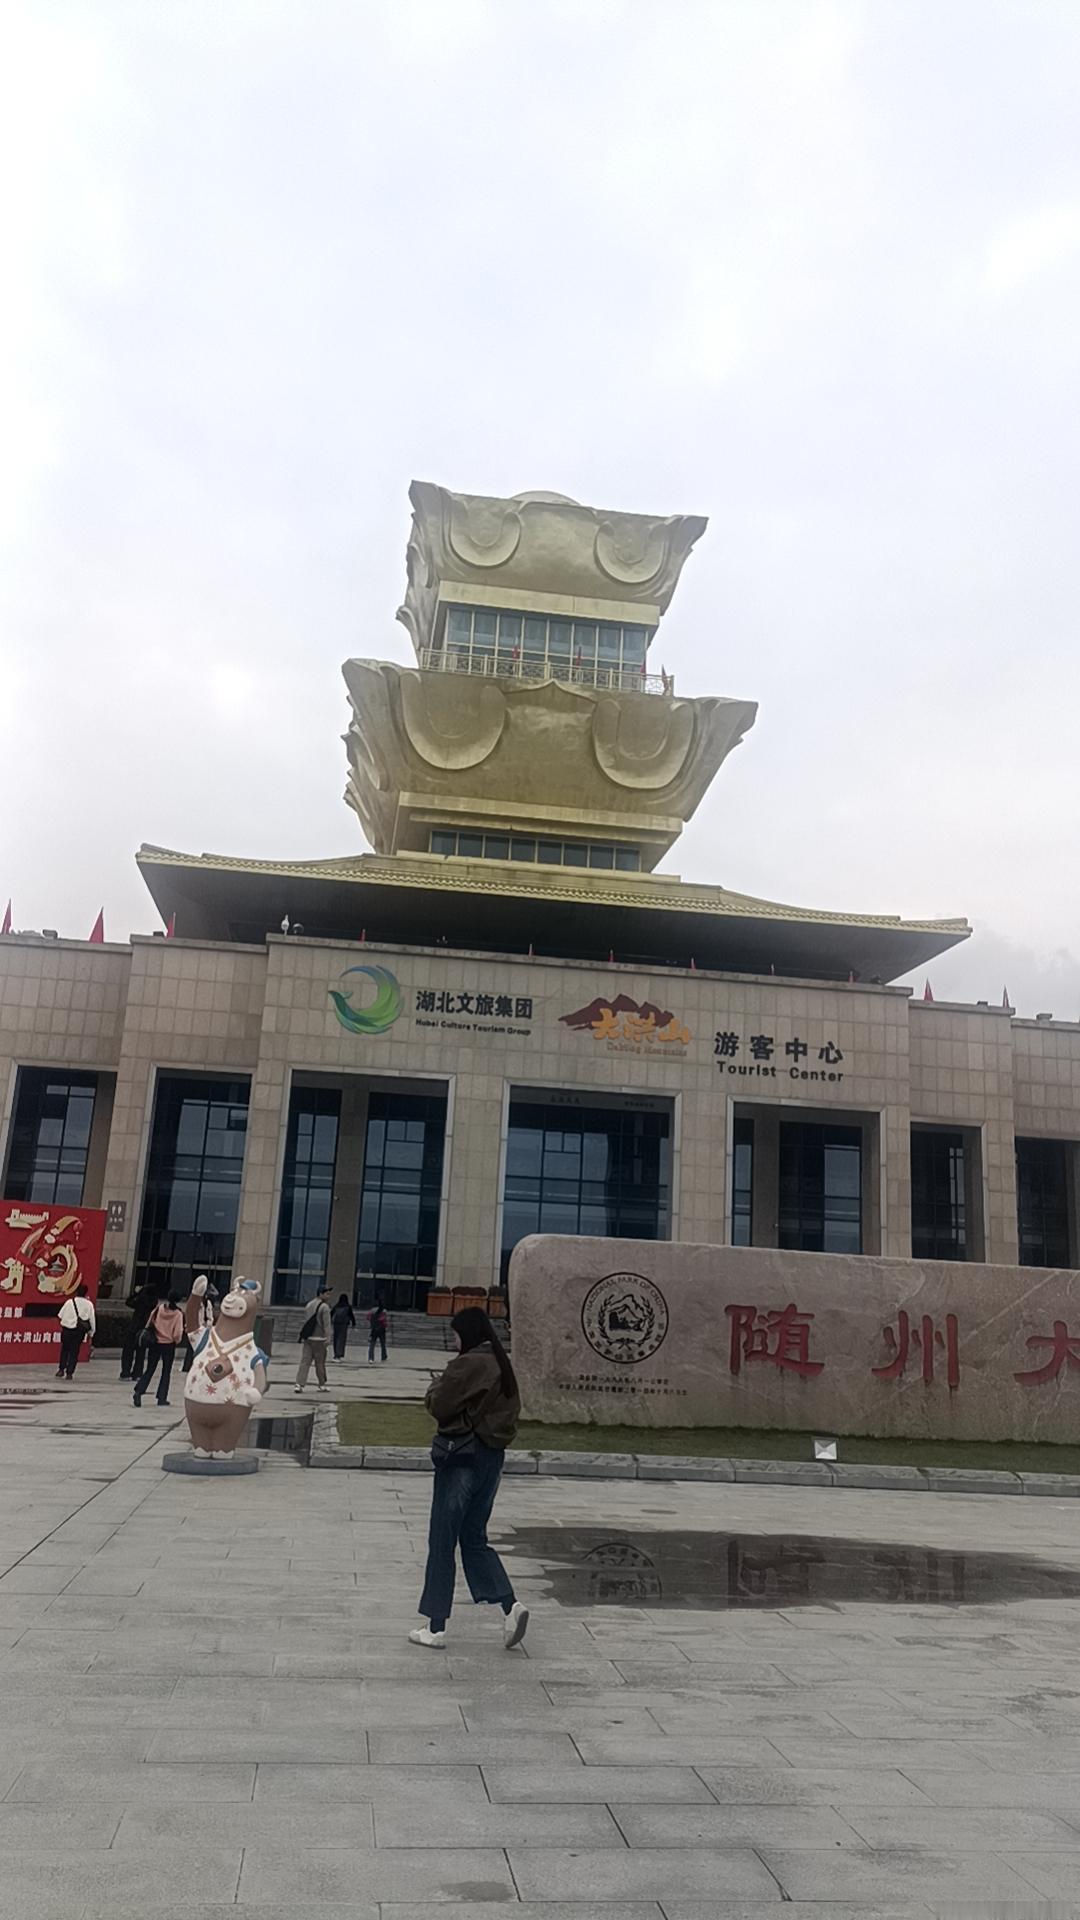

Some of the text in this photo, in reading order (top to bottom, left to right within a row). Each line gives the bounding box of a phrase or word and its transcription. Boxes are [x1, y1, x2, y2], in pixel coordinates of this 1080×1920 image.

[416, 990, 533, 1019] 湖北文旅集团
[416, 1019, 531, 1036] Hubei Culture Tourism Group
[591, 1007, 691, 1045] 大洪山
[714, 1031, 843, 1064] 游客中心
[717, 1060, 843, 1082] Tourist Center
